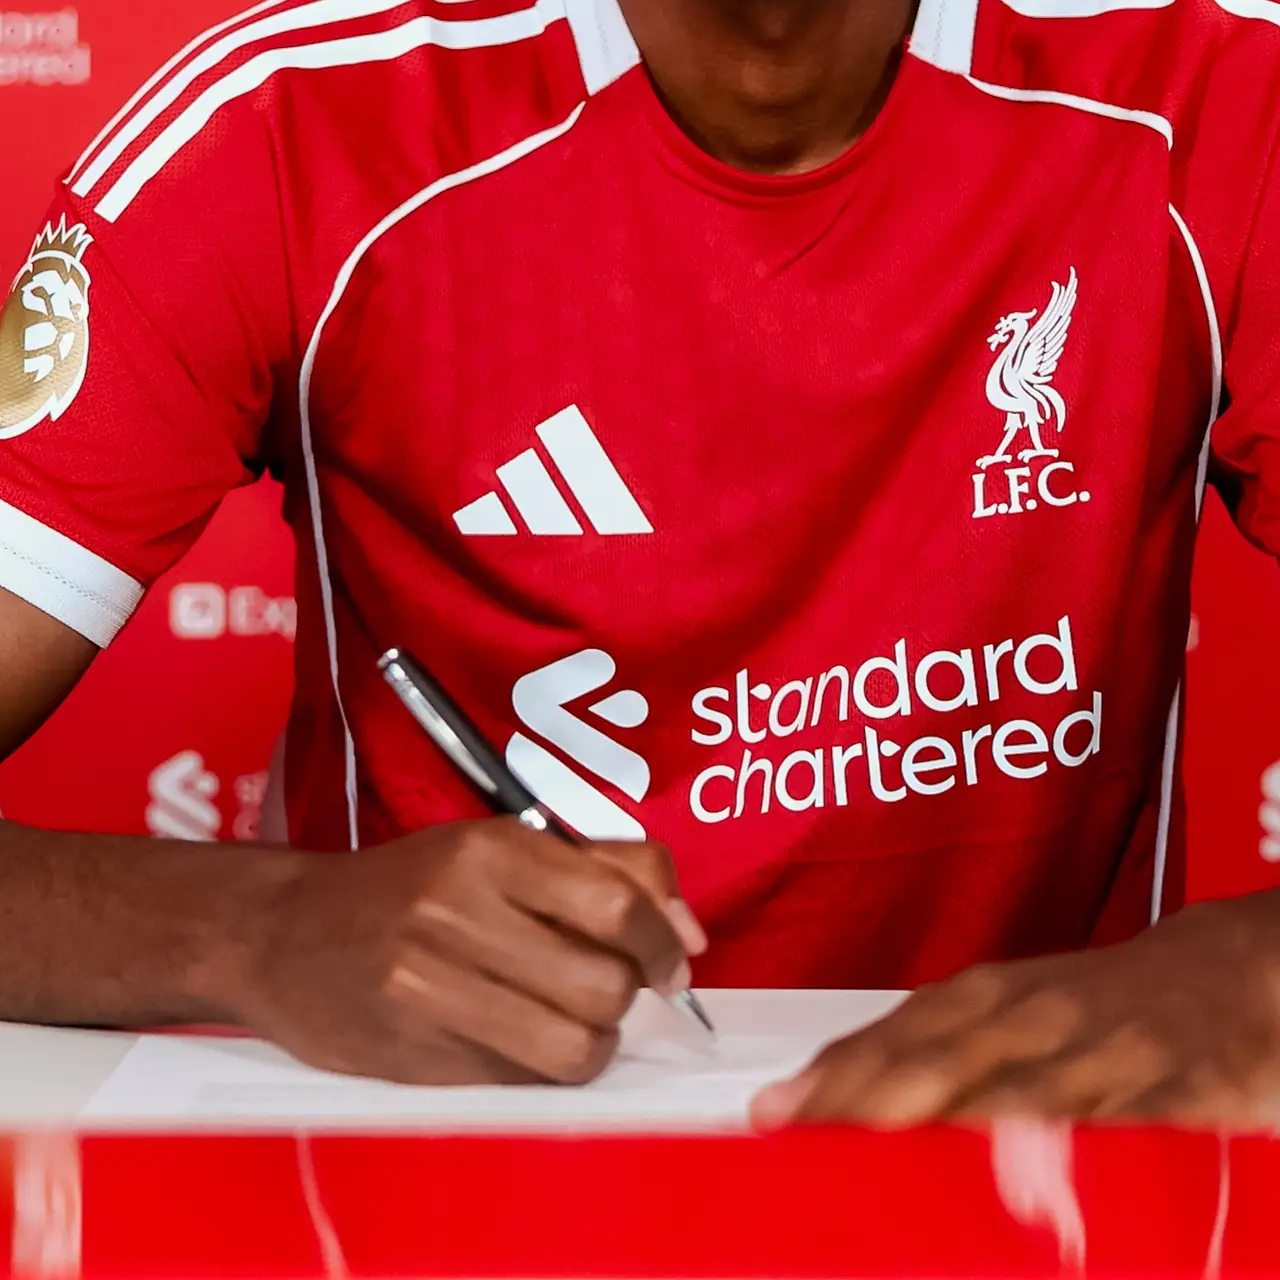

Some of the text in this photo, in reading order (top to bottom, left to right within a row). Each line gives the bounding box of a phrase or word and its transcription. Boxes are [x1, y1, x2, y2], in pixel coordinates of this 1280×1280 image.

[971, 461, 1091, 519] L.F.C.
[691, 615, 1078, 745] standard
[689, 691, 1102, 824] chartered
